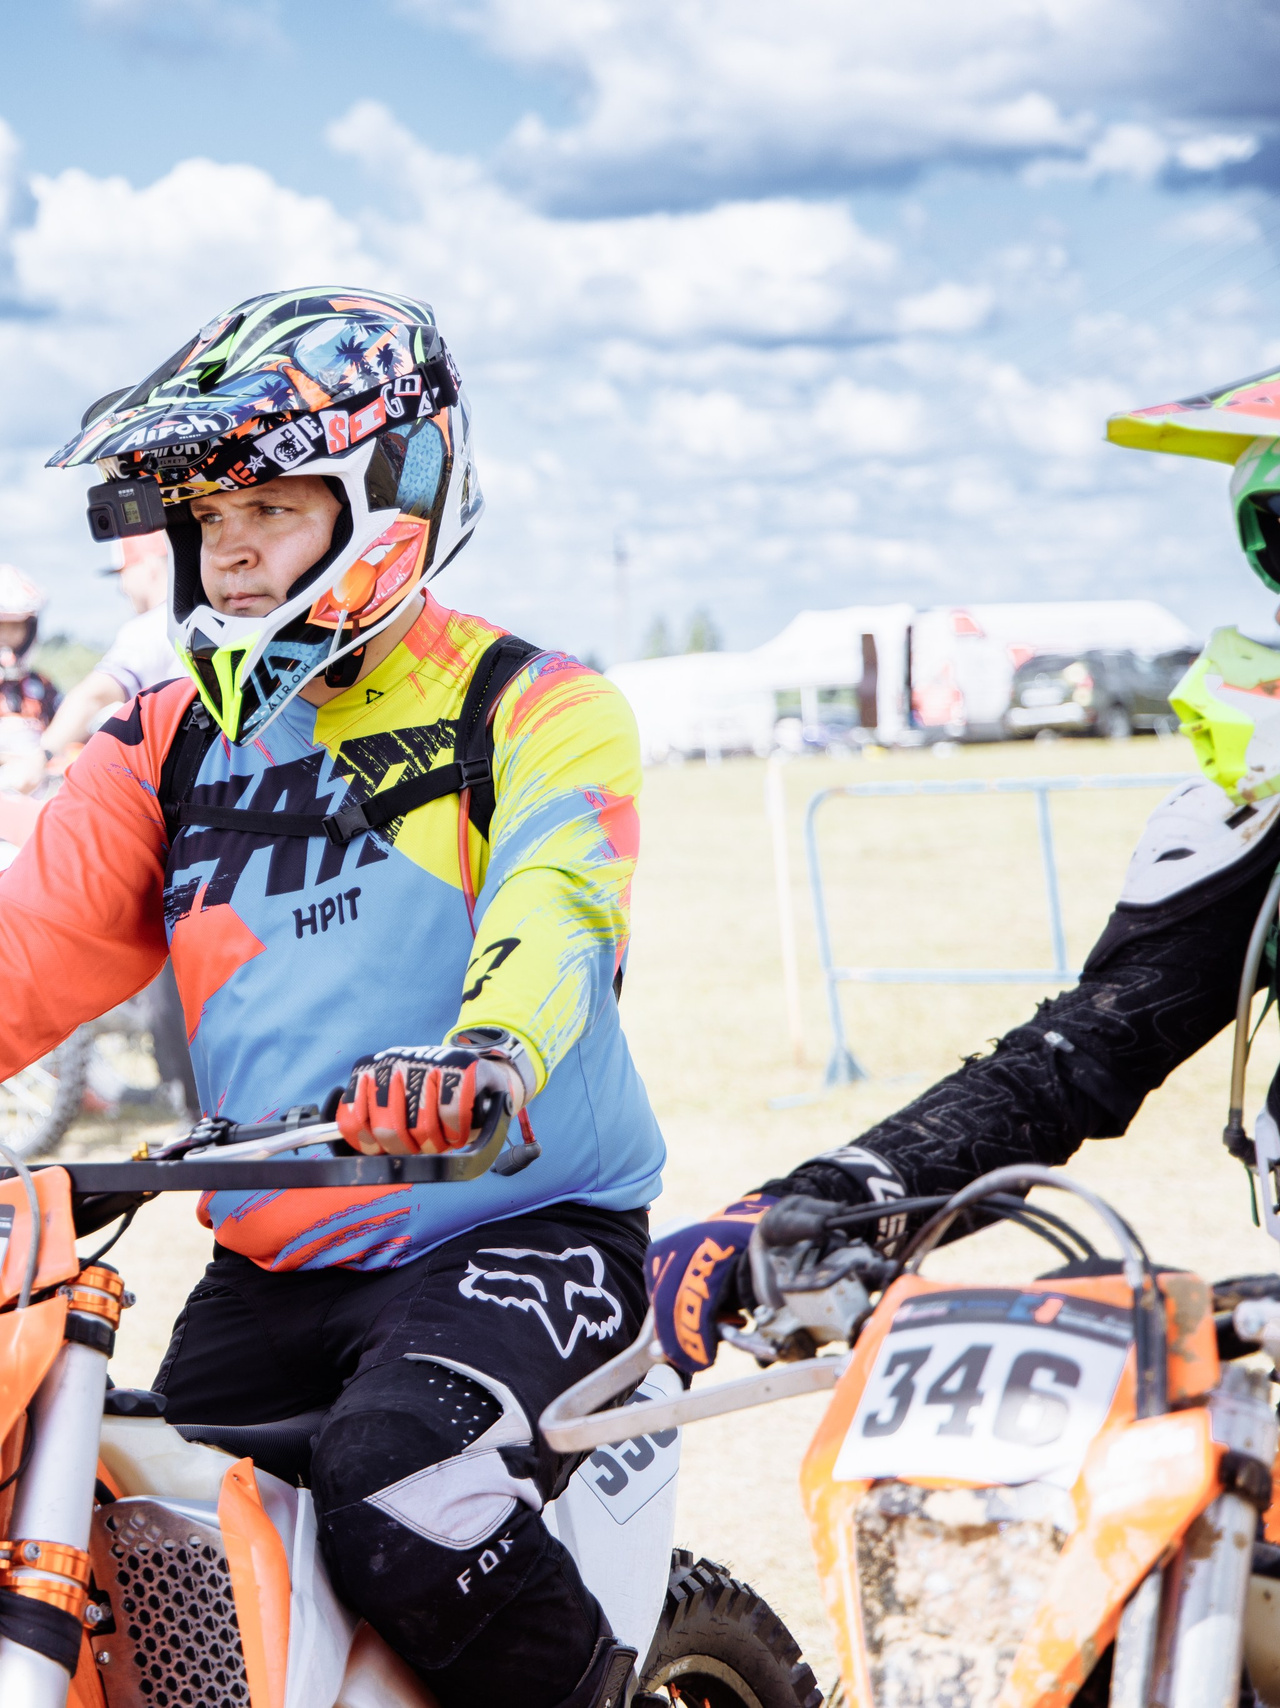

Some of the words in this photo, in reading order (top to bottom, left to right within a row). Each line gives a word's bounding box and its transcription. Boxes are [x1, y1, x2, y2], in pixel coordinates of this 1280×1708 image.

[113, 414, 221, 455] Airoh
[268, 663, 311, 711] AIROH
[292, 886, 362, 939] HPIT
[862, 1343, 1082, 1448] 346
[456, 1530, 514, 1595] FOX
